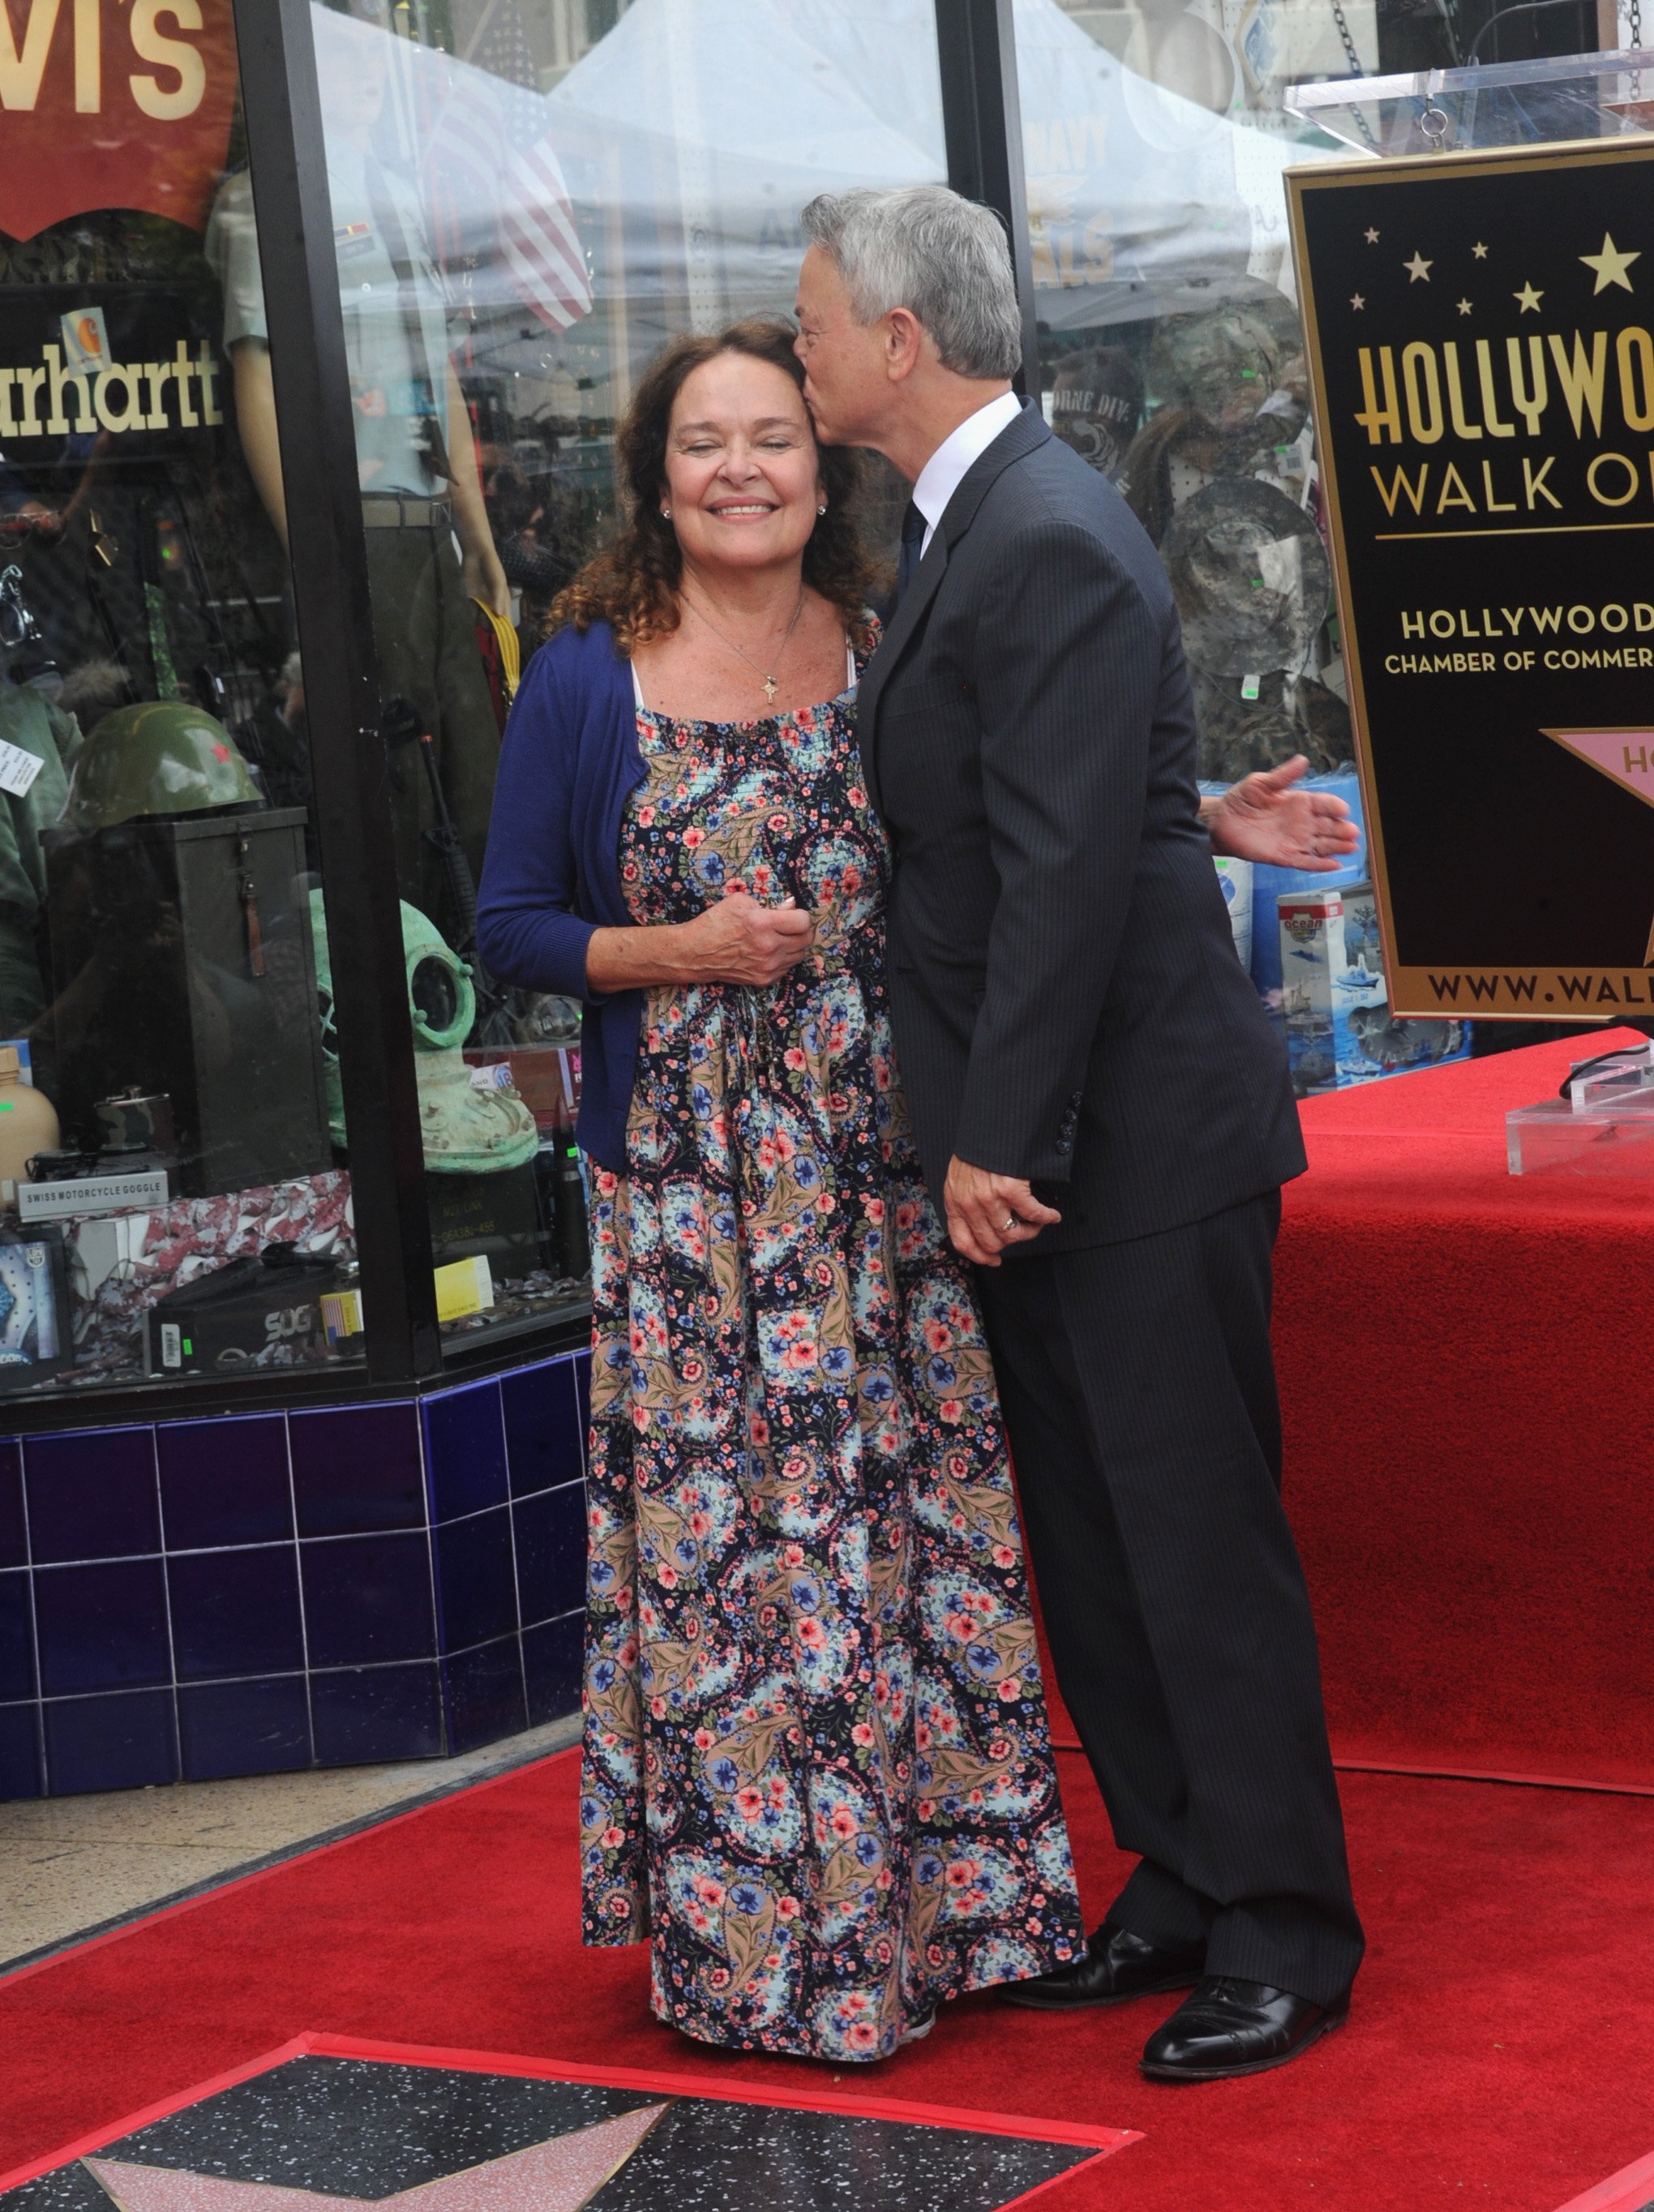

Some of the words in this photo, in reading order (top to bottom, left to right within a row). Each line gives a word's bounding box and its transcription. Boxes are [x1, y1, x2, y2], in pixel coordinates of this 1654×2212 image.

[0, 0, 206, 120] VIS
[1026, 115, 1108, 172] NAVY
[1354, 326, 1654, 444] HOLLYWO
[1370, 456, 1563, 517] WALK
[1587, 451, 1654, 508] O
[1401, 602, 1654, 639] HOLLYWOOD
[1385, 653, 1496, 675] CHAMBER
[1504, 651, 1536, 671] OF
[1544, 648, 1654, 671] COMMER
[1623, 745, 1654, 774] H
[1284, 919, 1322, 929] ocean
[1428, 975, 1654, 1003] WWW.WAL
[27, 1192, 56, 1203] SWISS
[58, 1185, 121, 1200] MOTORCYCLE
[123, 1182, 161, 1194] GOGGLE
[264, 1303, 313, 1342] SOG
